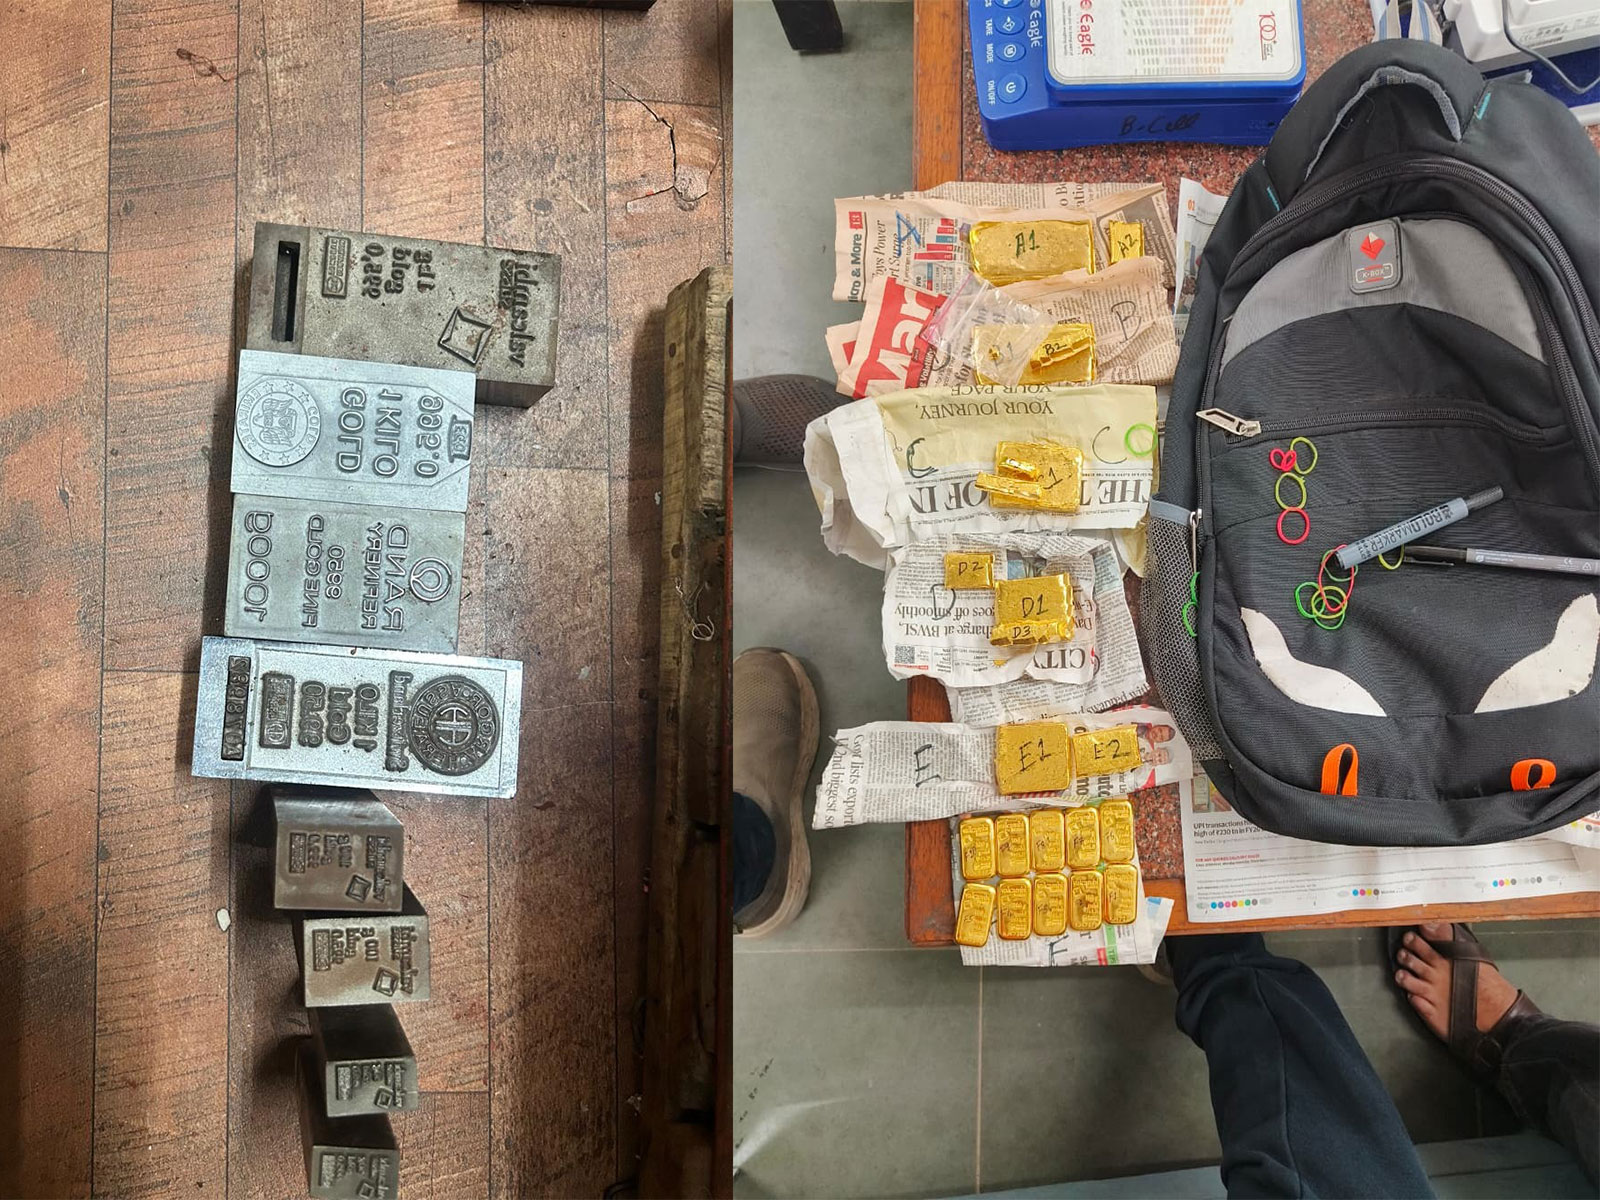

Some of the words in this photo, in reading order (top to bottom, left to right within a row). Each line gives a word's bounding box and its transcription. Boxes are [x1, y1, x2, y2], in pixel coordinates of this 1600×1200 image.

[1027, 10, 1043, 48] Eagle
[1077, 14, 1095, 55] Eagle
[873, 220, 886, 255] Power
[1015, 230, 1040, 258] A1
[1119, 233, 1139, 259] A2
[851, 234, 862, 265] More
[851, 268, 860, 277] &
[1110, 299, 1143, 344] B
[1043, 343, 1067, 355] B2
[914, 394, 999, 419] JOURNEY,
[1004, 400, 1053, 415] YOUR
[945, 480, 987, 511] OF
[958, 561, 984, 576] D2
[894, 602, 953, 619] smoothly
[930, 583, 957, 621] D
[953, 606, 969, 620] off
[1021, 597, 1049, 618] D1
[898, 621, 939, 638] BWSL,
[943, 623, 956, 635] at
[1011, 626, 1031, 639] D3
[832, 751, 846, 769] 2nd
[1019, 741, 1052, 772] E1
[1093, 738, 1122, 760] E2
[850, 762, 864, 785] lists
[826, 772, 844, 812] biggest
[1206, 820, 1243, 828] transactions
